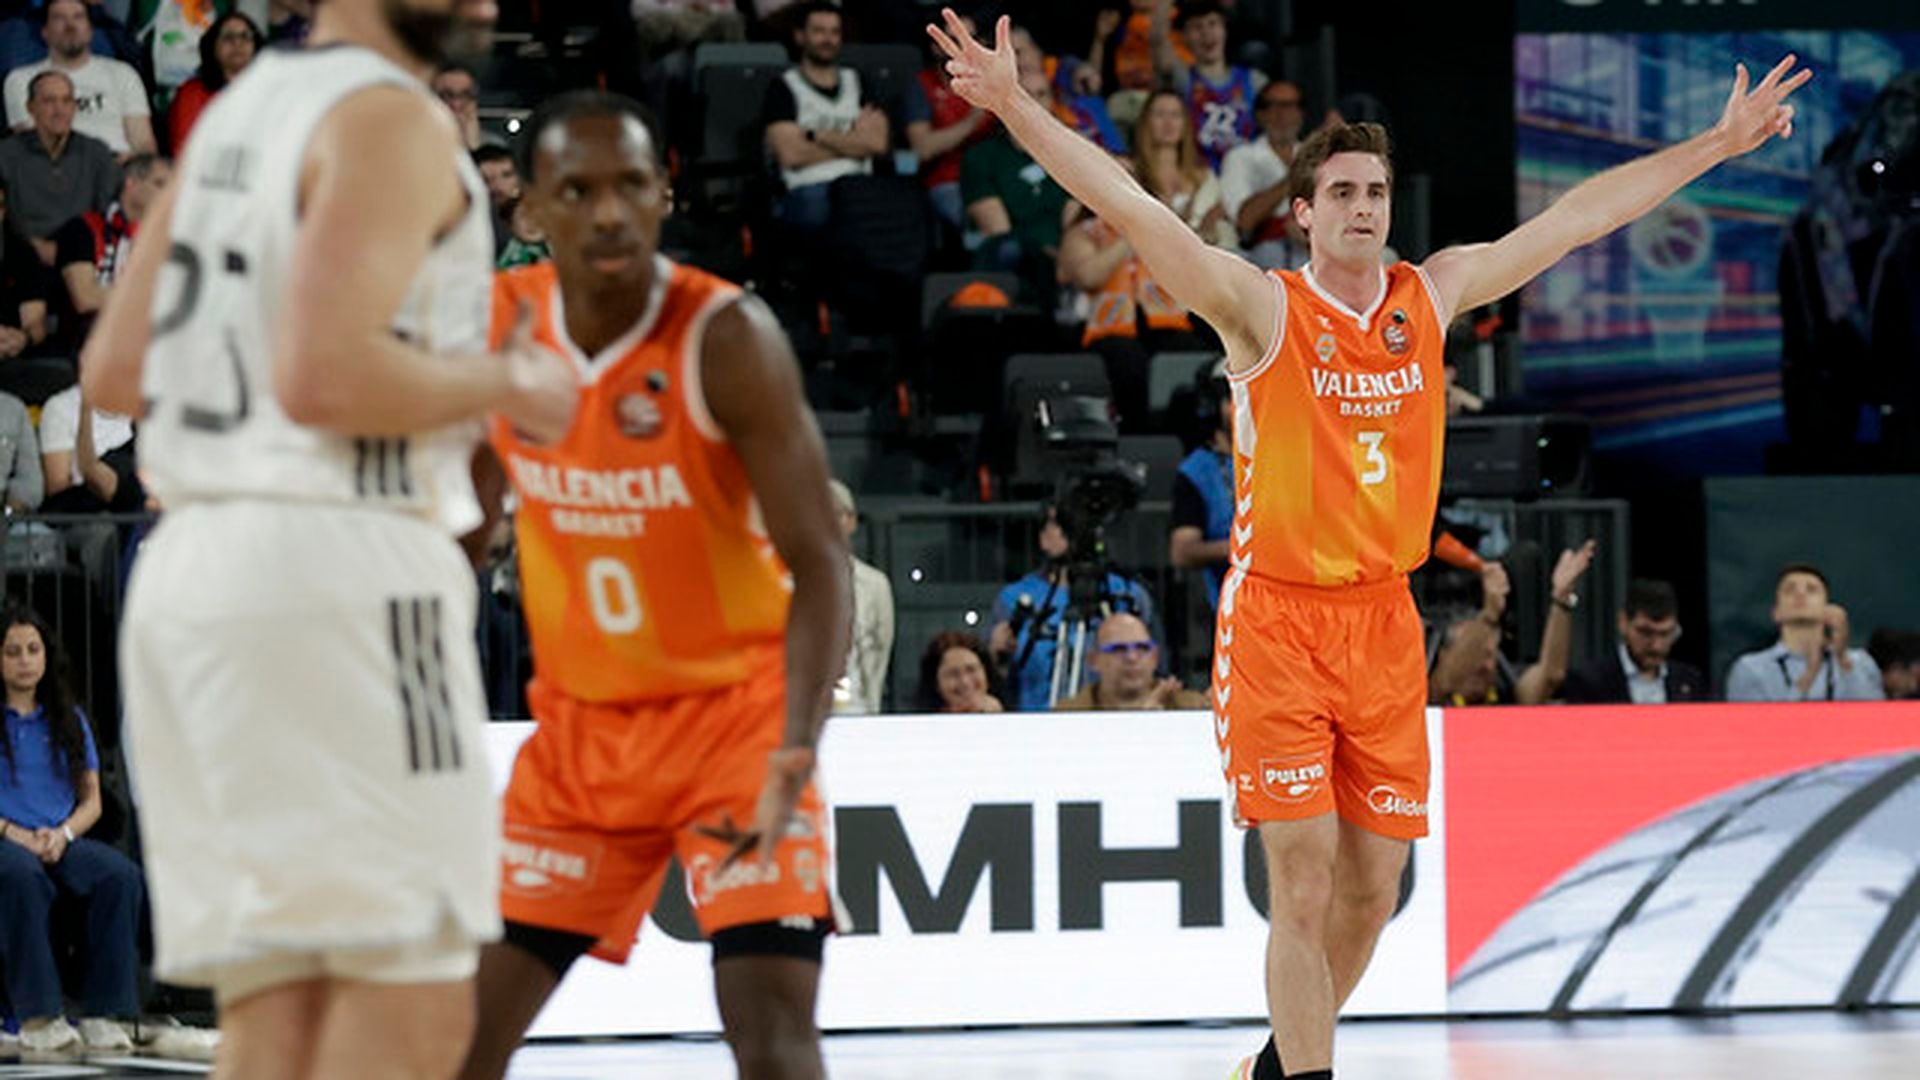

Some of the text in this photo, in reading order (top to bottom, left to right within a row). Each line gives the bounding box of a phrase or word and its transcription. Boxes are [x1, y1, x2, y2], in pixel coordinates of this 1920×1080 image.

[1312, 362, 1424, 397] VALENCIA
[1340, 399, 1402, 417] BASKET
[1357, 431, 1387, 484] 3
[508, 453, 692, 509] VALENCIA
[586, 557, 643, 633] 0
[1265, 764, 1324, 784] PULEVA
